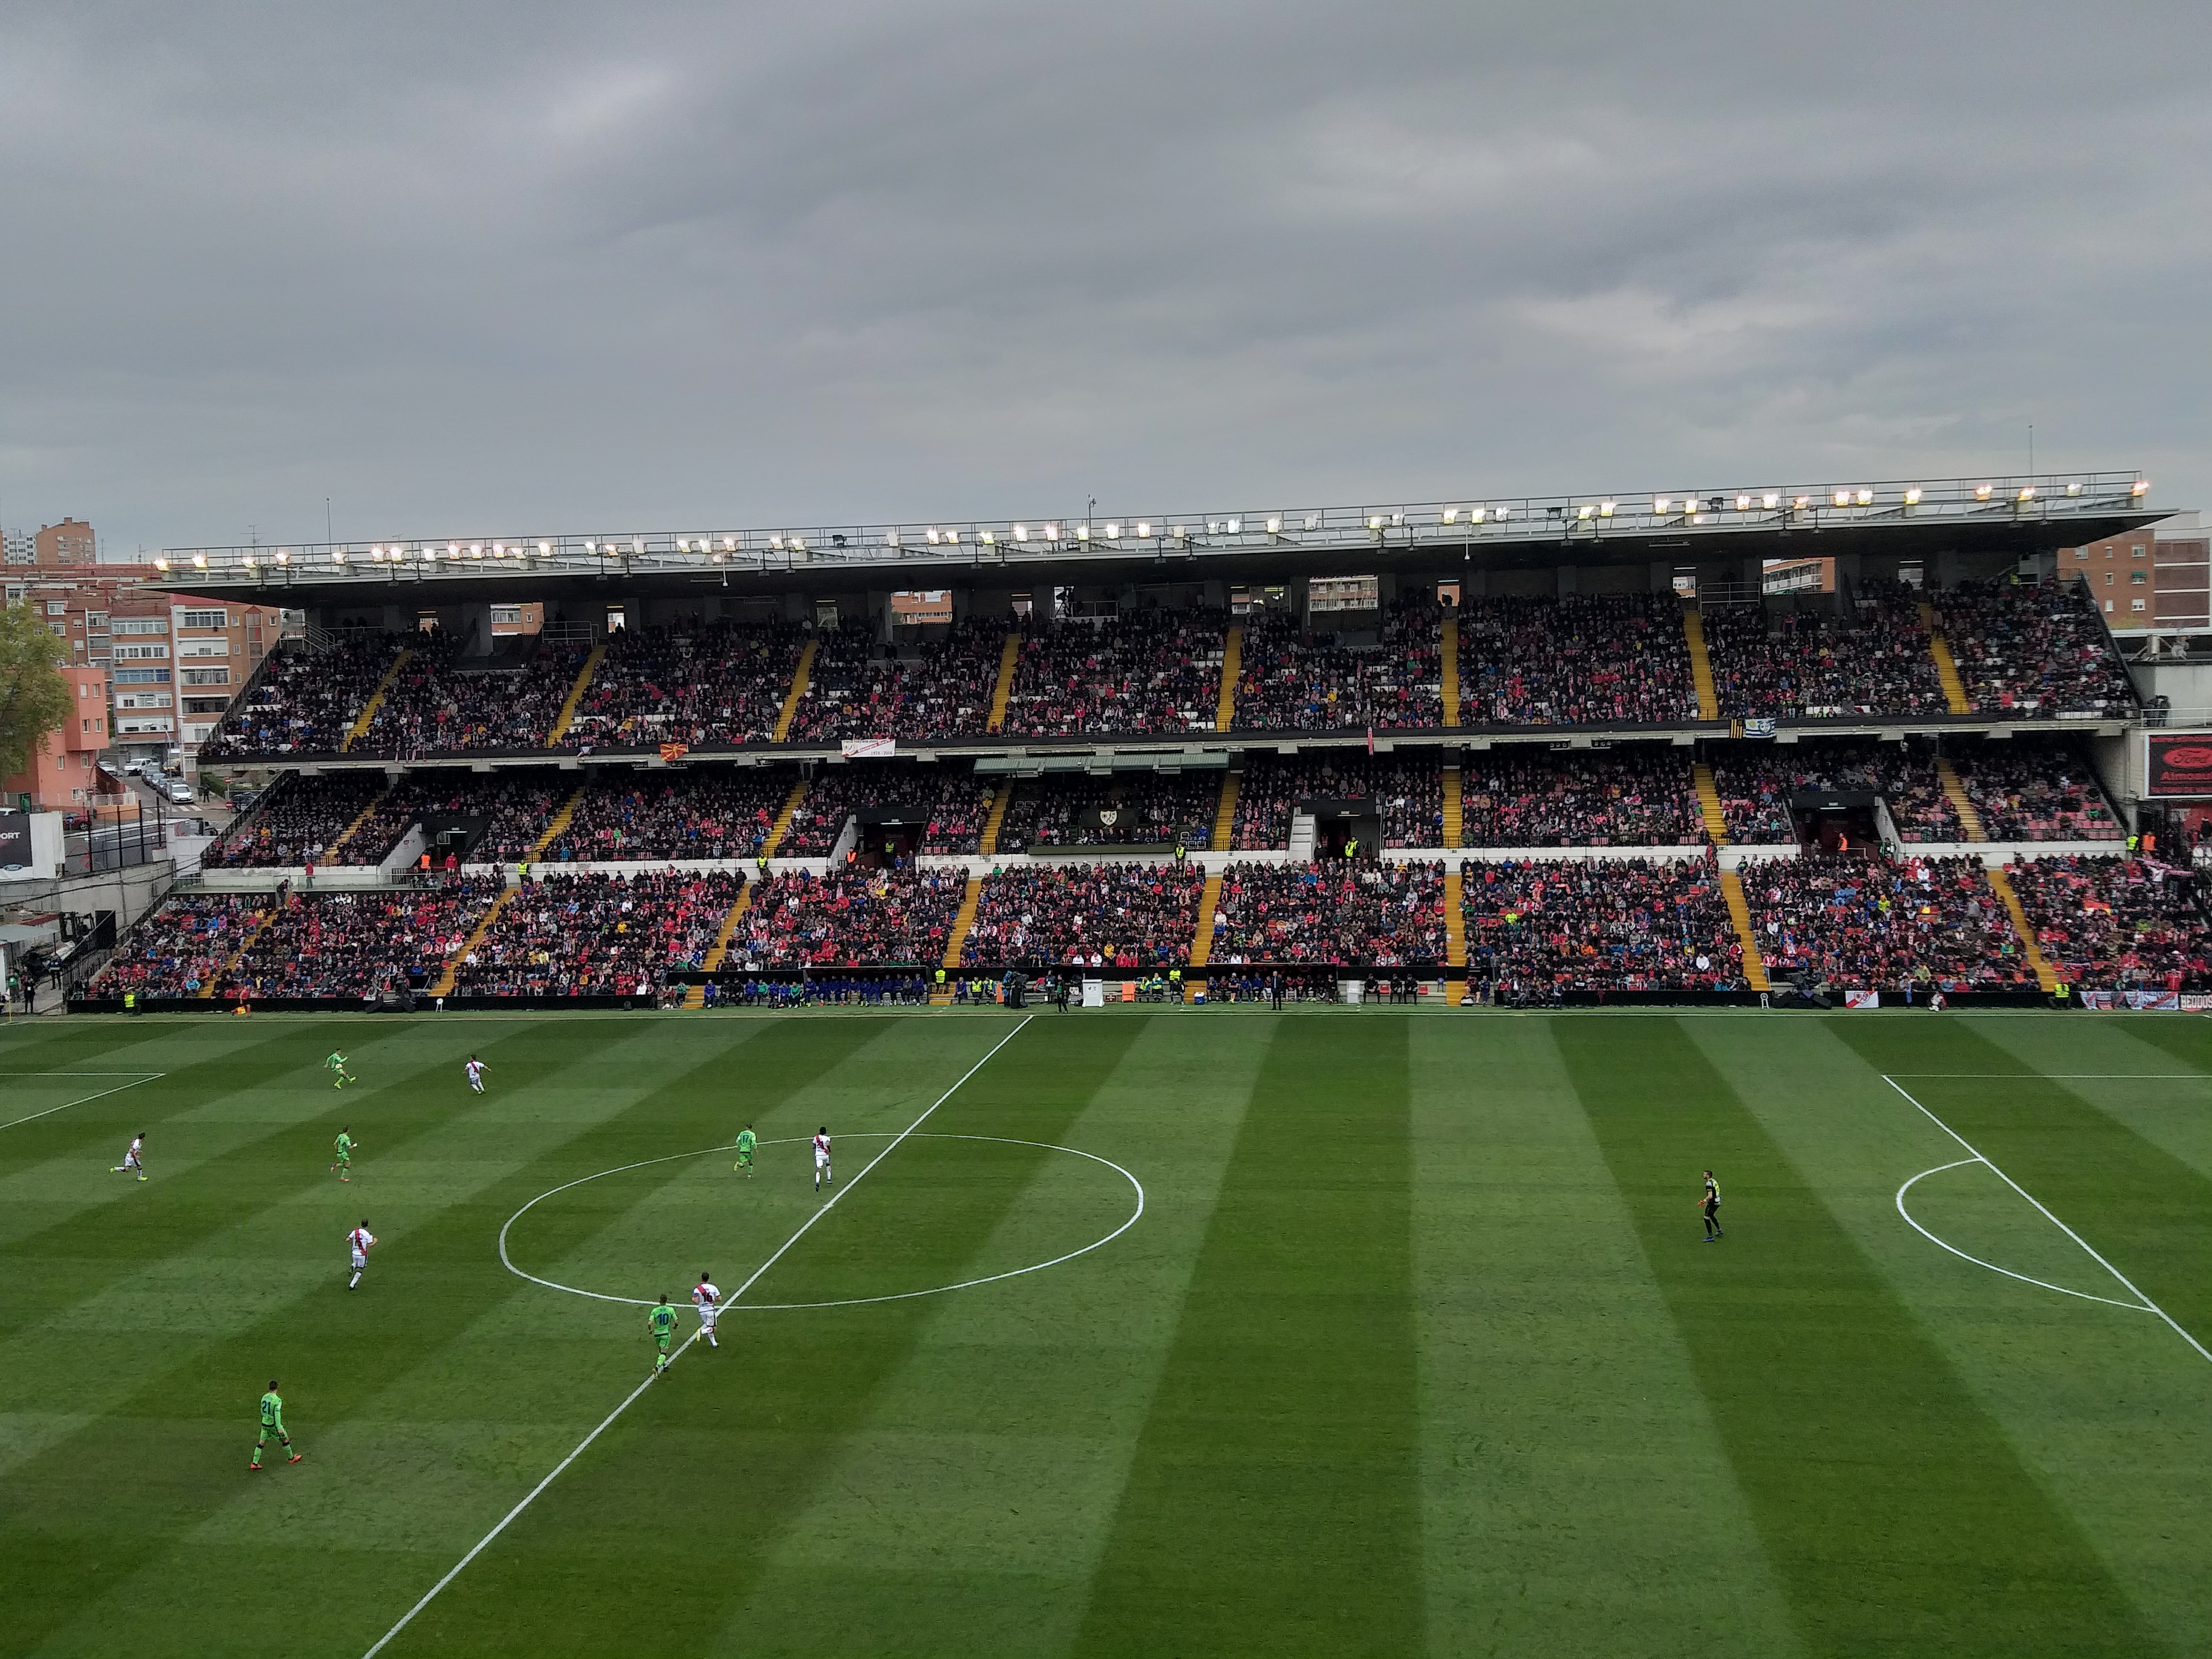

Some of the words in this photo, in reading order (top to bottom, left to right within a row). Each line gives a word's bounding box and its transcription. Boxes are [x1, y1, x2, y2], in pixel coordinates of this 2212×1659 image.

[2174, 750, 2211, 763] Ford
[743, 1134, 749, 1143] 17
[658, 1313, 669, 1325] 10
[262, 1400, 271, 1414] 21
